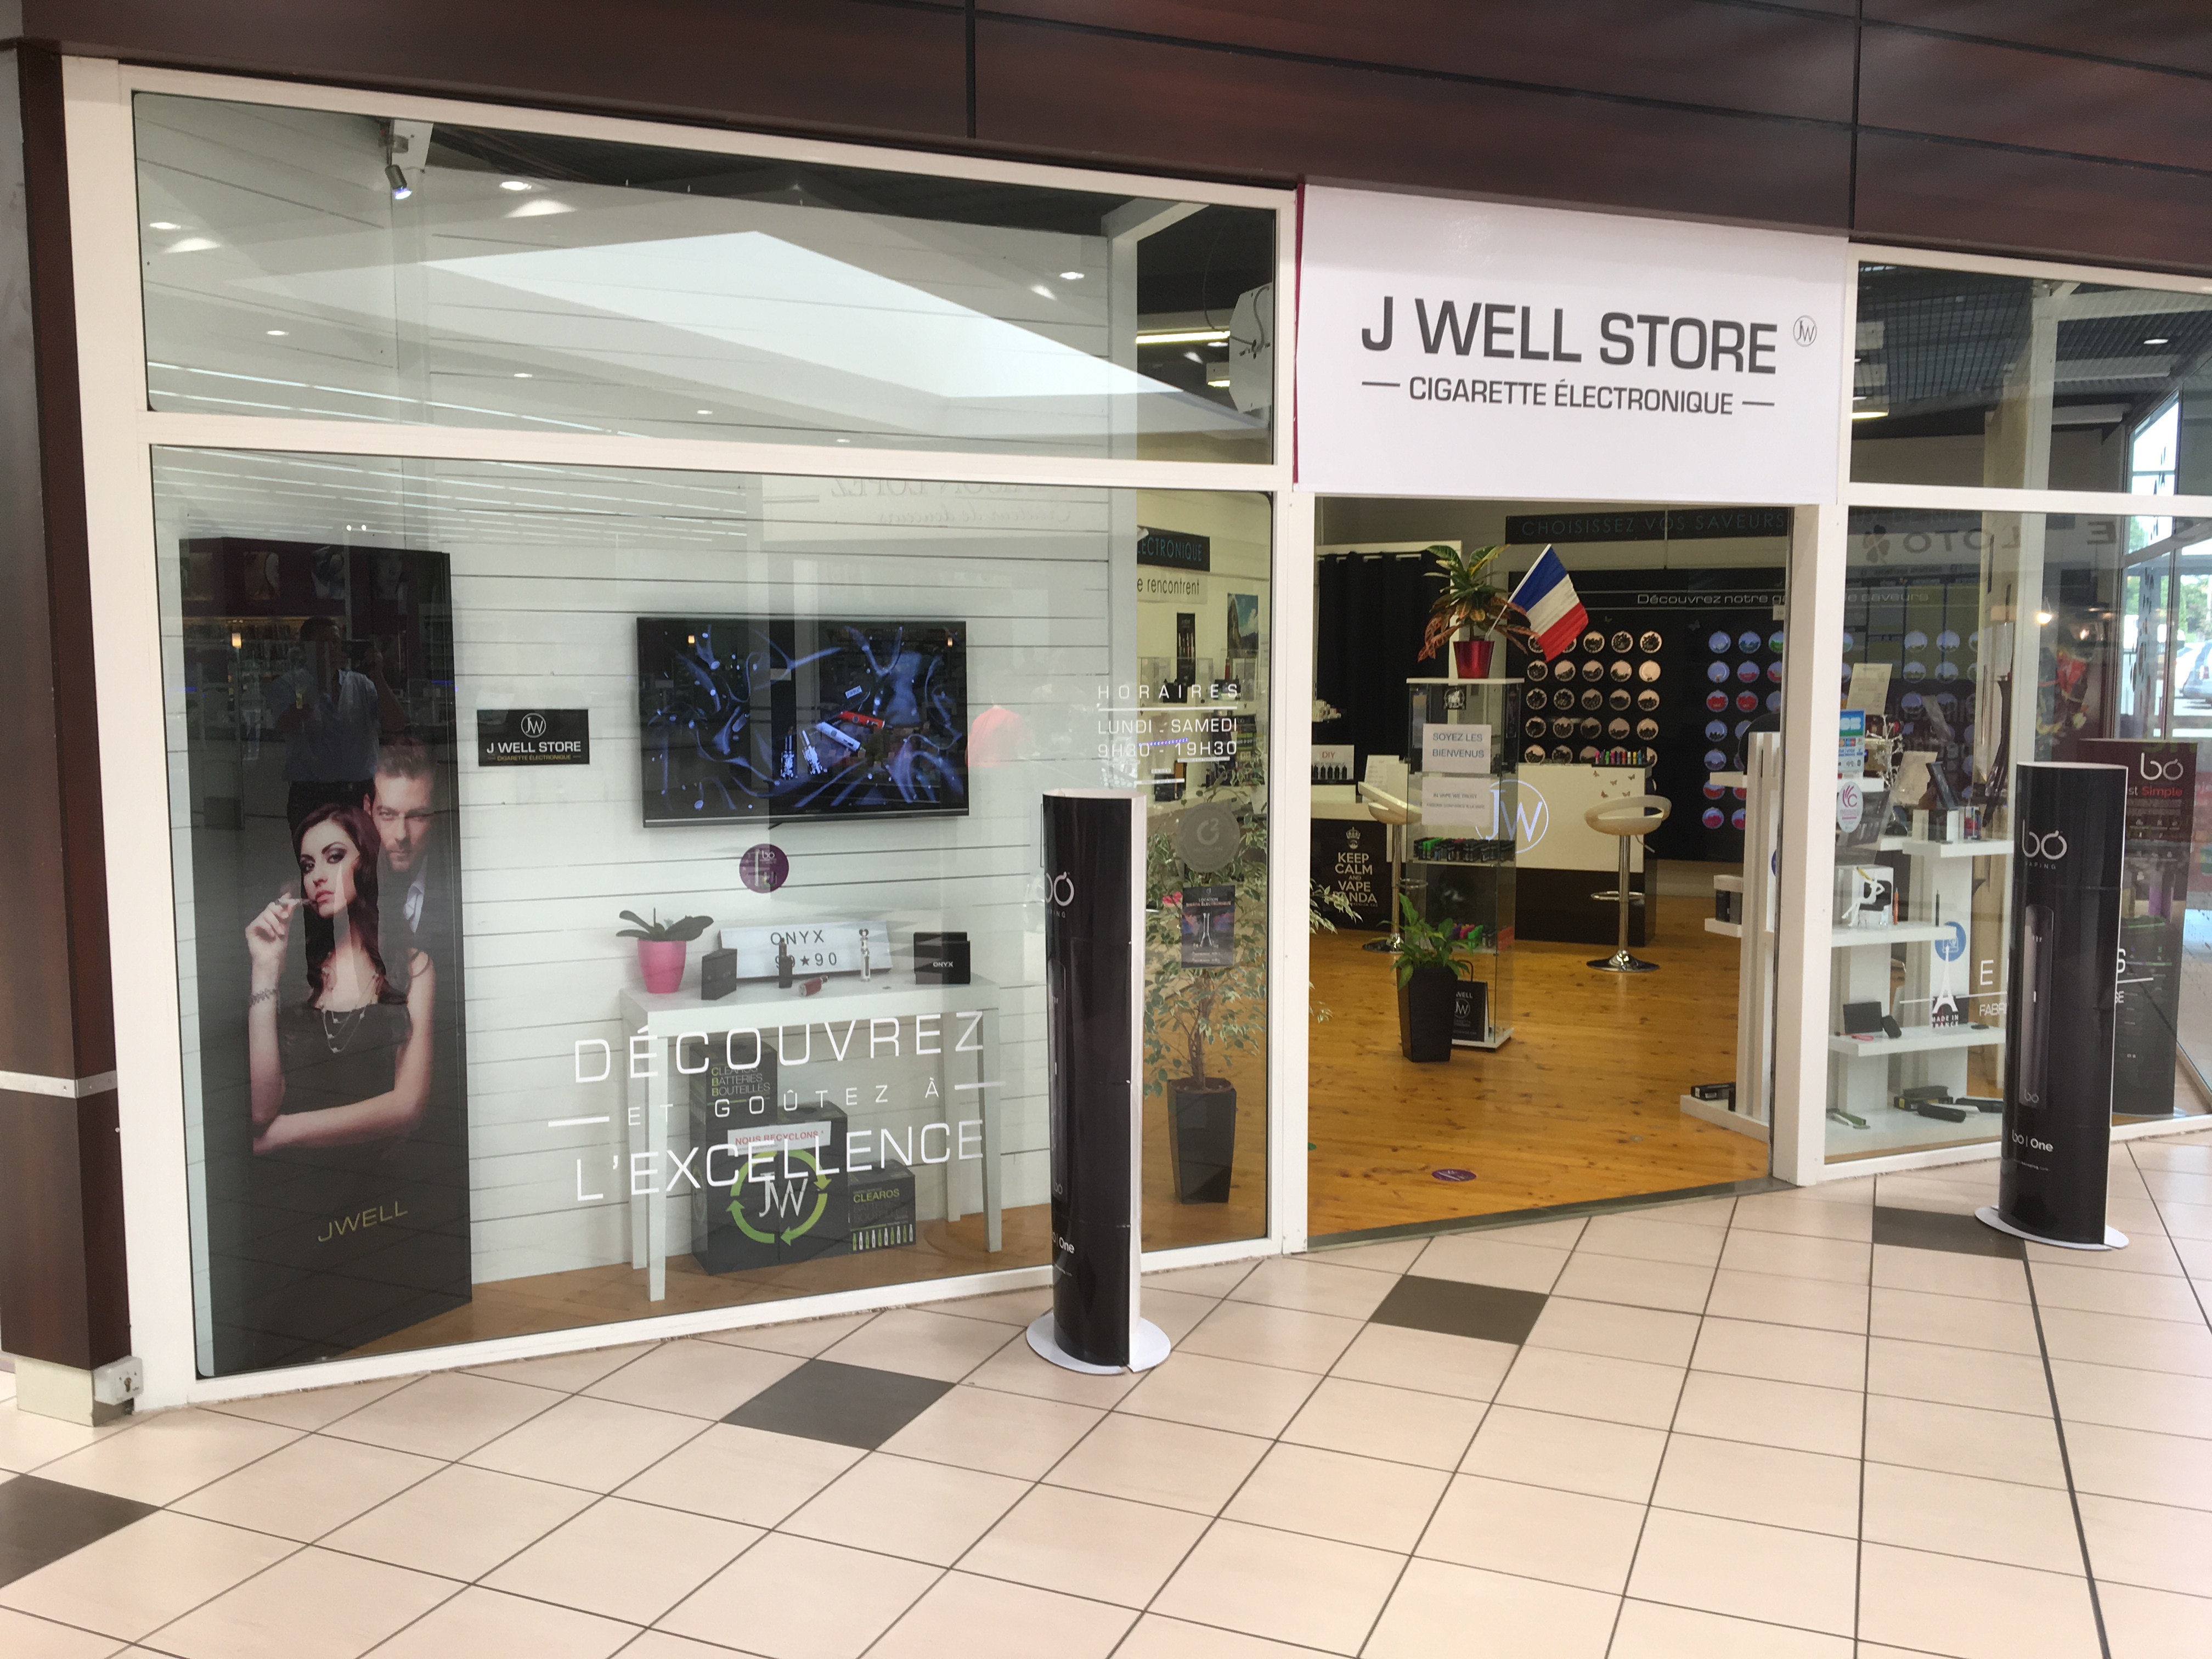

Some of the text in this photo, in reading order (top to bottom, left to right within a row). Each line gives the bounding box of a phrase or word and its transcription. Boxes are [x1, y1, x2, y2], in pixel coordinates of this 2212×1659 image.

[1361, 296, 1777, 374] J WELL STORE
[1409, 375, 1734, 415] CIGARETTE ÉLECTRONIQUE
[1522, 513, 1785, 537] CHOISISSEZ VOS SAVEURS
[1147, 577, 1200, 595] rencontrent
[1637, 594, 1721, 604] Découvrez
[1724, 594, 1768, 603] notre
[1098, 684, 1238, 700] HORAIRES
[1098, 719, 1152, 735] LUNDI
[1171, 718, 1237, 733] SAMEDI
[1432, 732, 1483, 742] SOYEZ LES
[486, 741, 582, 754] J WELL STORE
[1174, 741, 1237, 756] 19H30
[1322, 751, 1336, 759] DIY
[1432, 748, 1485, 758] BIENVENUS
[2141, 786, 2183, 798] Simple
[1338, 852, 1369, 864] KEEP
[1335, 864, 1373, 875] CALM
[1338, 880, 1371, 893] VAPE
[770, 930, 825, 946] ONYX
[574, 1010, 984, 1084] DÉCOUVREZ
[712, 1073, 763, 1087] BATTERIES
[712, 1082, 771, 1097] BOUTEILLES
[627, 1076, 940, 1126] ET GOÛTEZ À
[735, 1131, 819, 1145] NOUS RECYCLONS
[2030, 1138, 2054, 1152] One
[577, 1119, 984, 1201] L'EXCELLENCE
[853, 1188, 900, 1204] CLEAROS
[317, 1200, 409, 1243] JWELL
[1059, 1237, 1075, 1254] One
